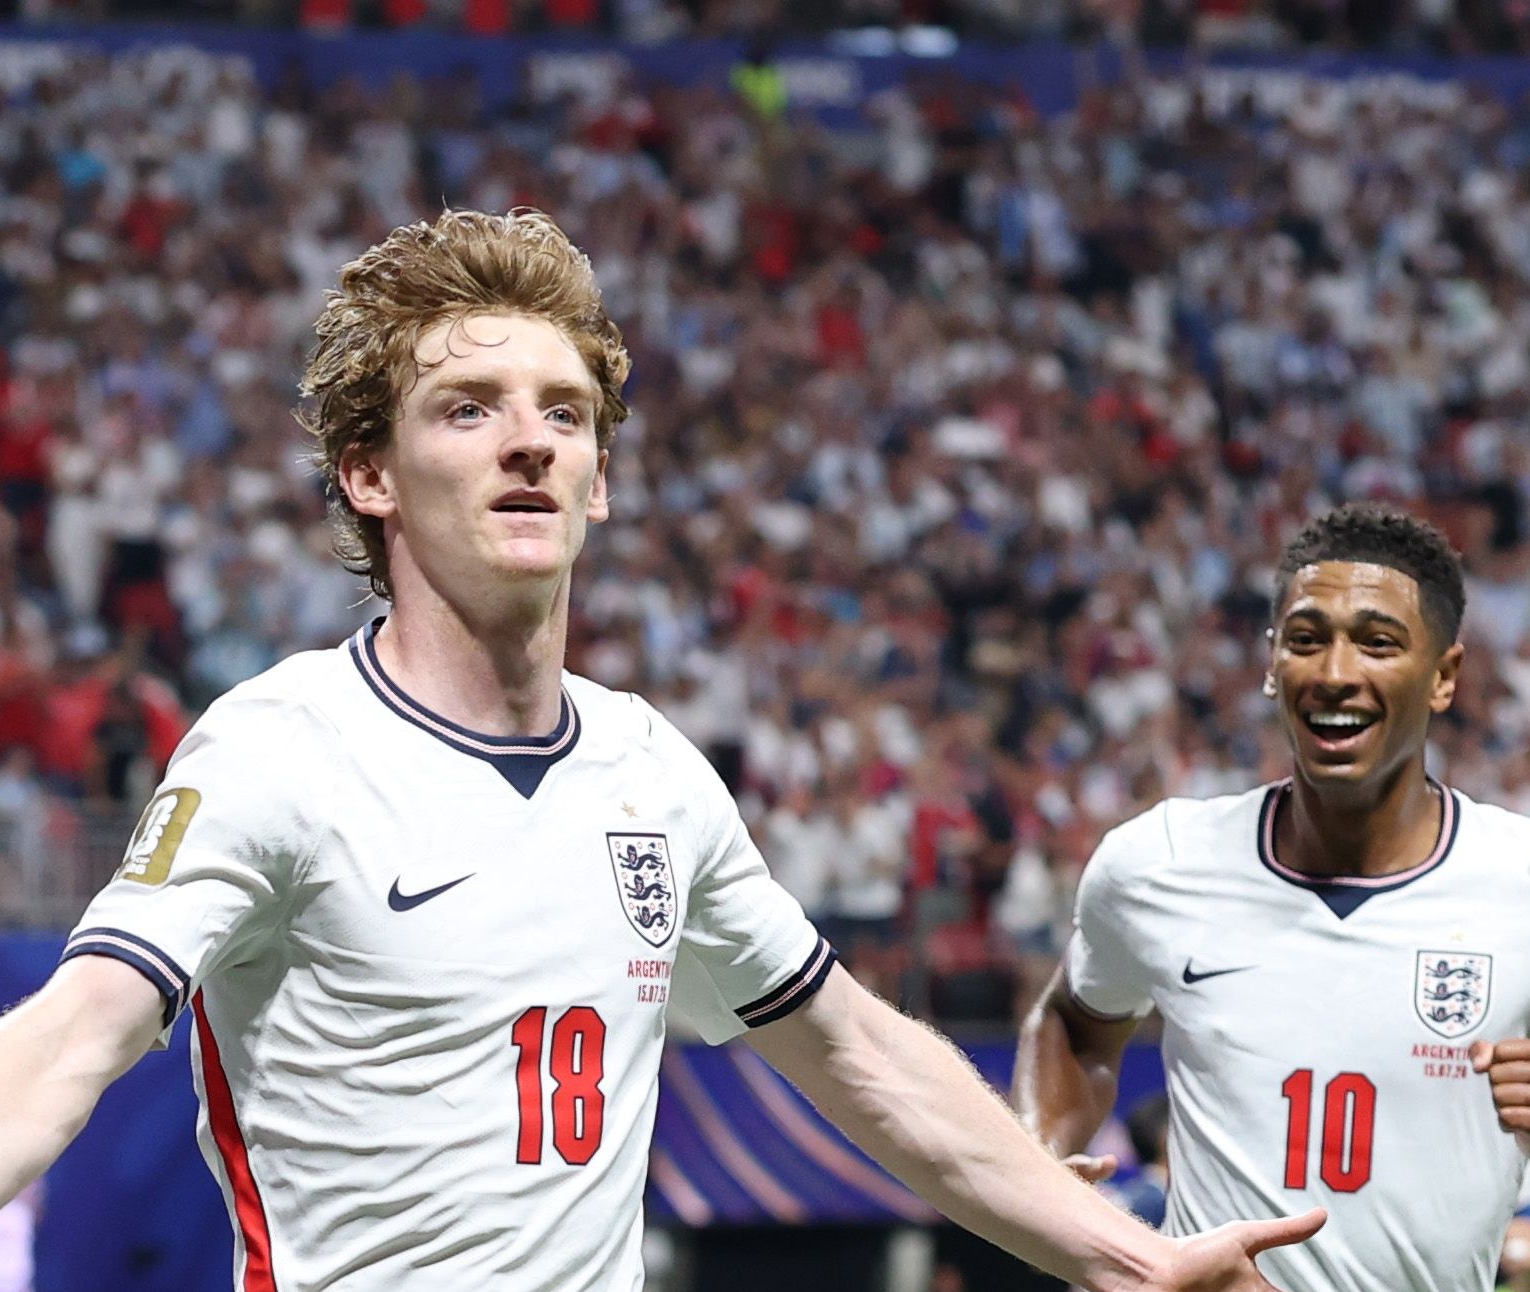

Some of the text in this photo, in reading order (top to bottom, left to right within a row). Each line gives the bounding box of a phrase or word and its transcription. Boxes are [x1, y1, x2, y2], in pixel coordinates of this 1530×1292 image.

[627, 960, 671, 979] ARGENT
[512, 1006, 606, 1166] 18
[1412, 1044, 1469, 1060] ARGENTI
[1282, 1069, 1377, 1194] 10
